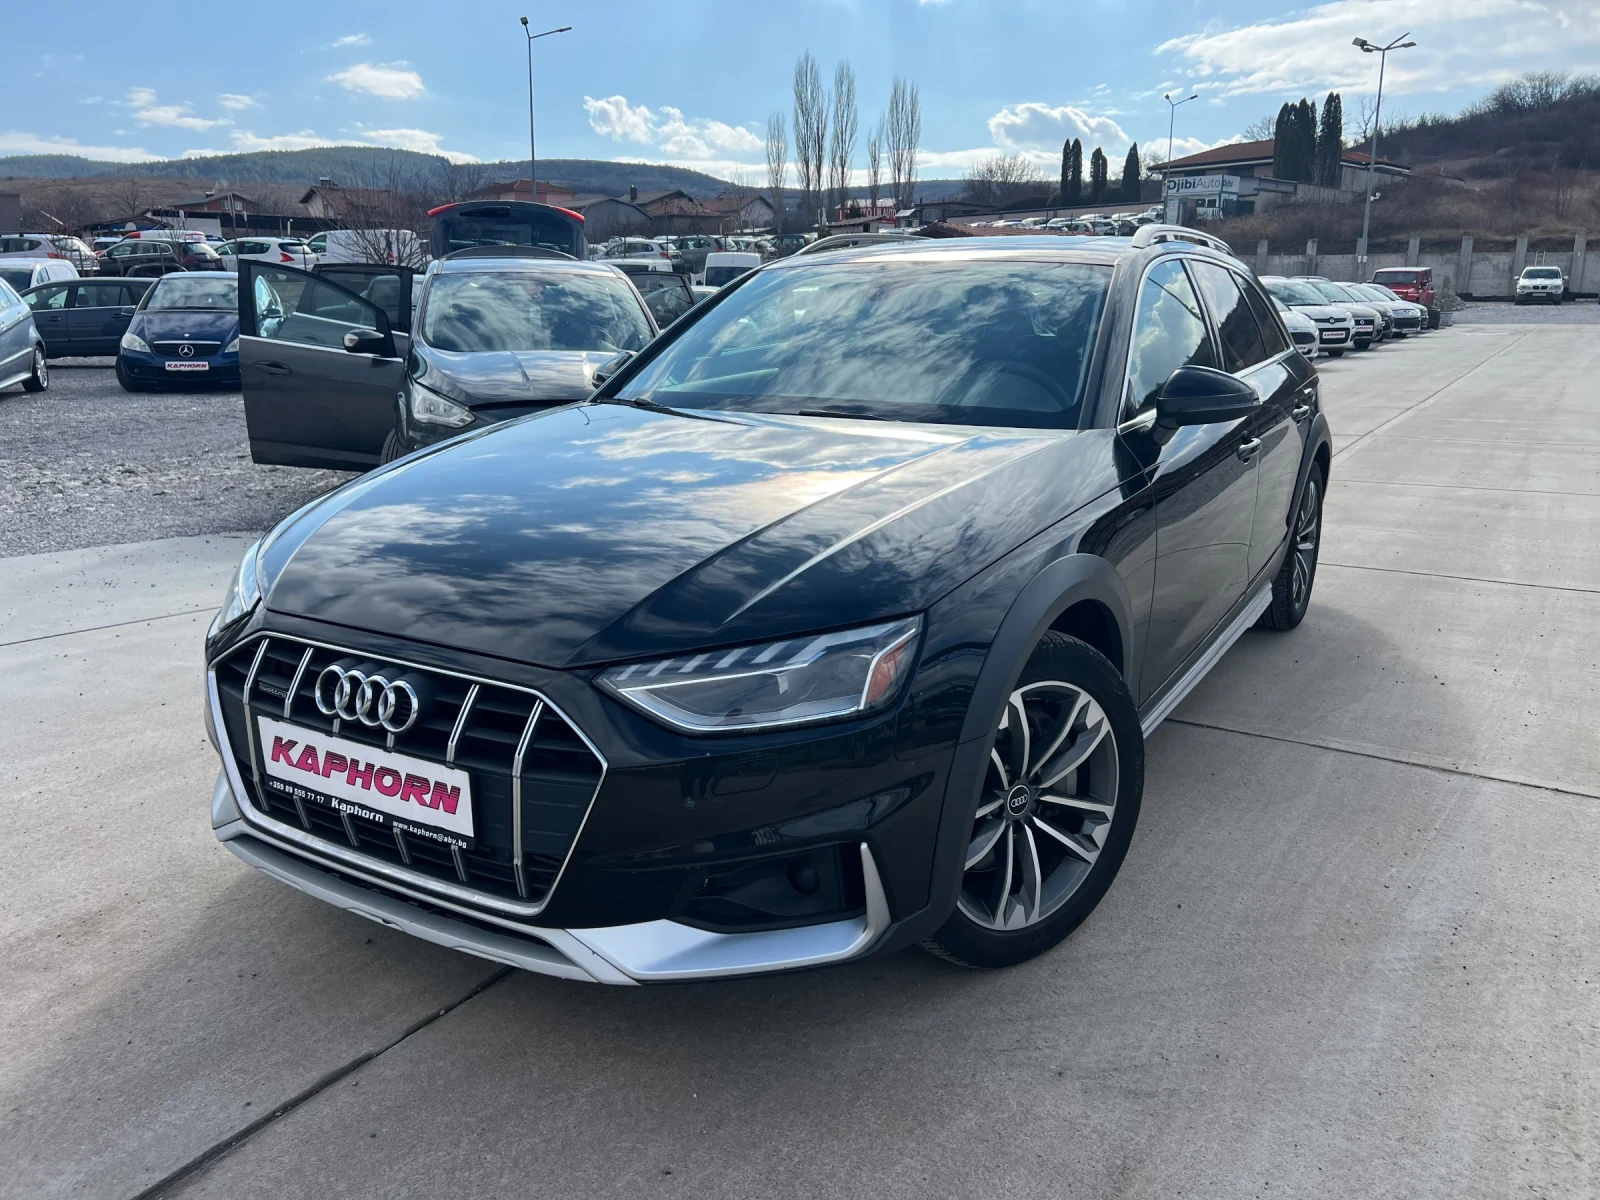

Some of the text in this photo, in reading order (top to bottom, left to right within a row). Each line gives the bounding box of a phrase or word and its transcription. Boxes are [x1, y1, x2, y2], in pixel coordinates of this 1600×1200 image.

[258, 684, 287, 698] quattro
[271, 735, 461, 815] KAPHORN
[269, 781, 284, 791] +359
[294, 788, 306, 798] 555
[307, 792, 315, 801] 77
[316, 795, 325, 804] 17
[331, 797, 384, 823] Kaphorn
[393, 820, 467, 849] www.kaphorn@abv.bg
